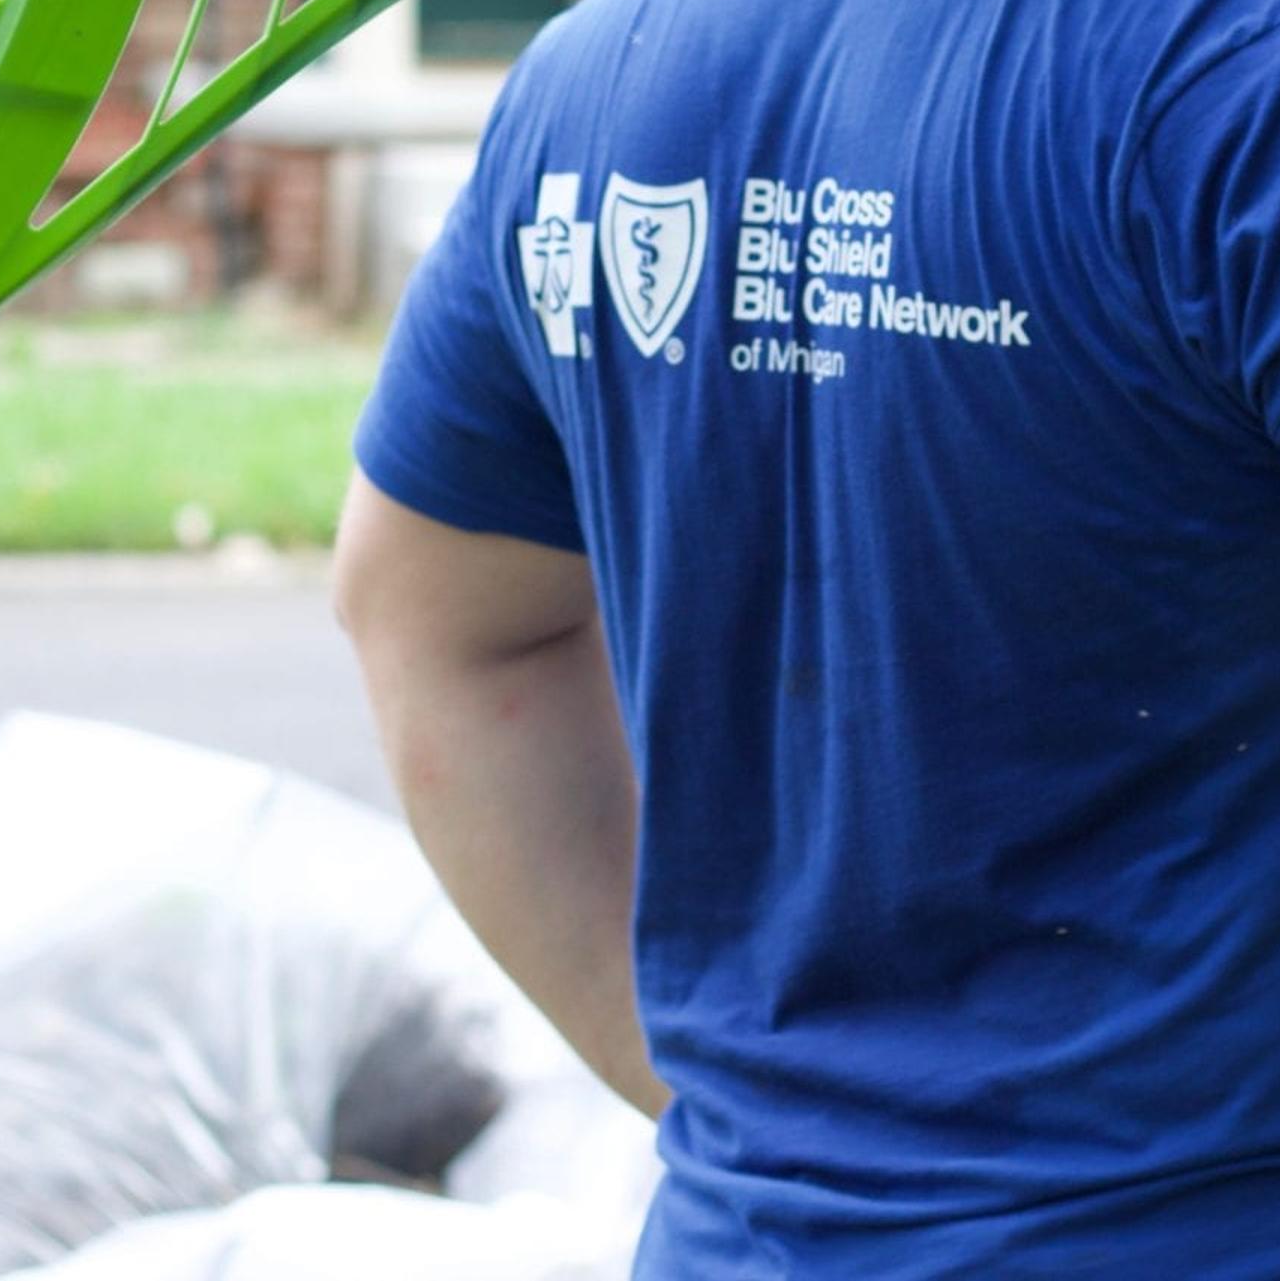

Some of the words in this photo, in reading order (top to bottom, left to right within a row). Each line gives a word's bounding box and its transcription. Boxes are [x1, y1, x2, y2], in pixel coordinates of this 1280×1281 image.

[741, 178, 806, 224] Blu
[812, 177, 894, 227] Cross
[737, 226, 798, 274] Blu
[805, 226, 892, 278] Shield
[732, 275, 794, 323] Blu
[802, 277, 863, 329] Care
[869, 283, 1031, 346] Network
[730, 338, 762, 371] of
